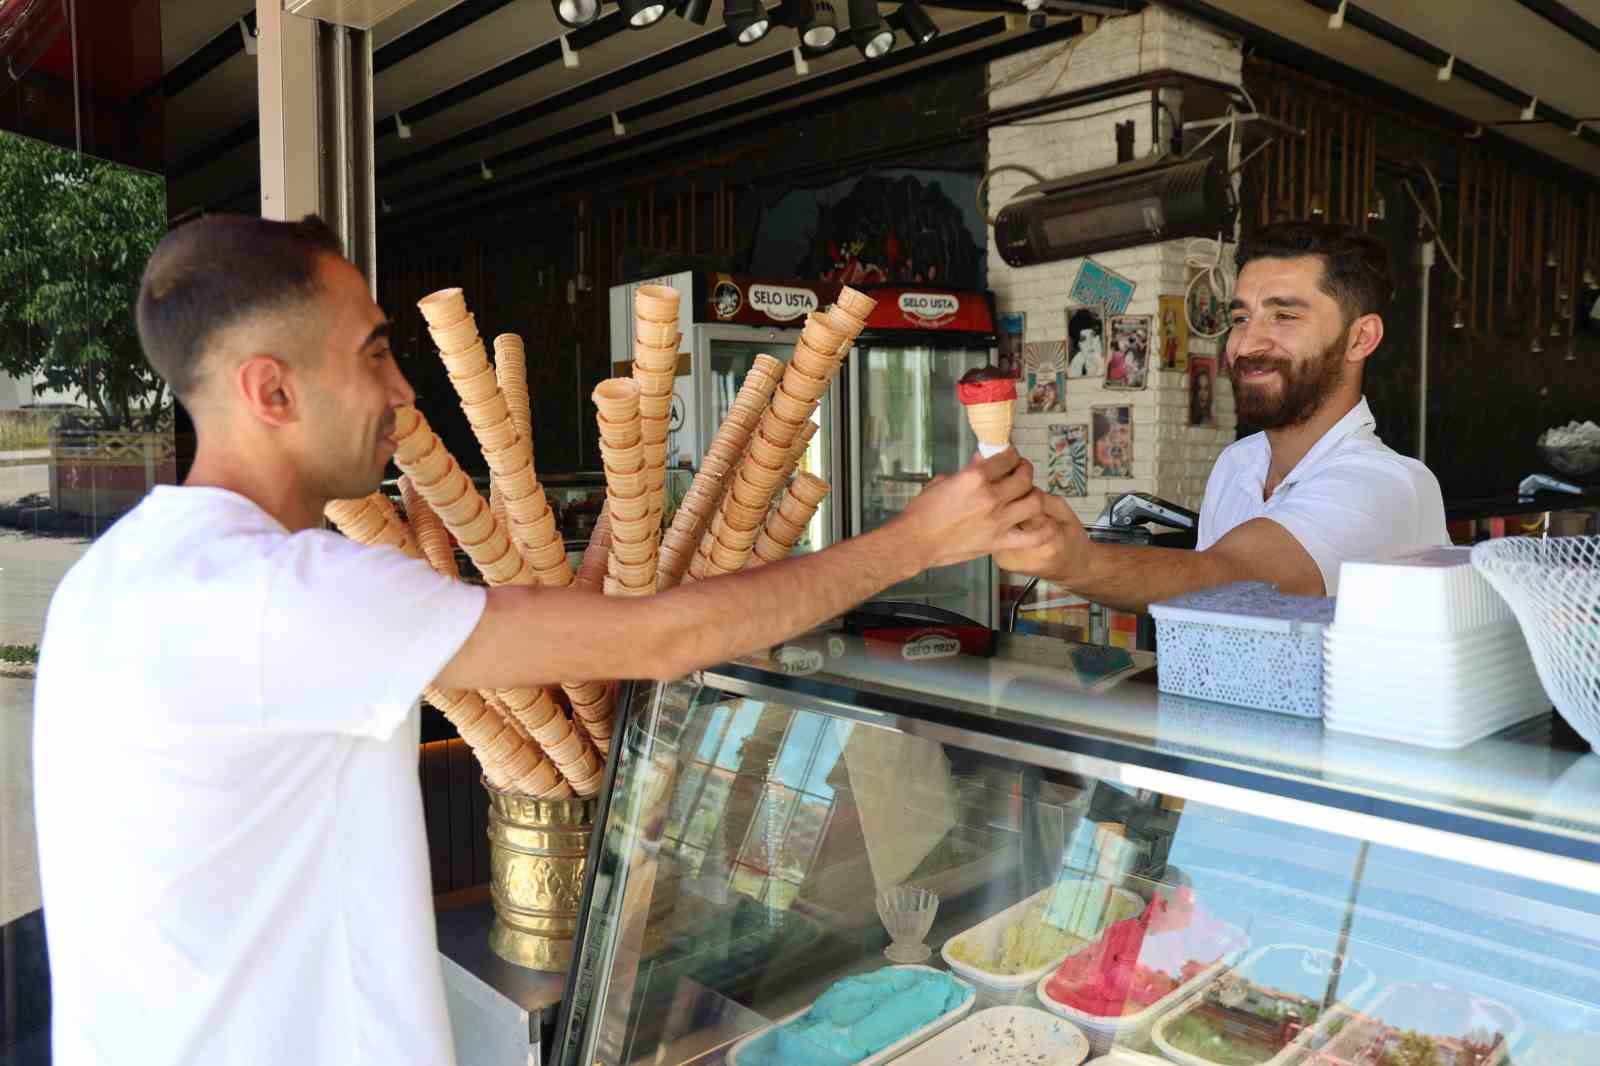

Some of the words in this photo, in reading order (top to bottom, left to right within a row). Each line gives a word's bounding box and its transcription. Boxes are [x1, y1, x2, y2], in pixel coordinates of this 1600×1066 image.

[753, 290, 783, 306] SELO
[784, 293, 814, 309] USTA
[903, 297, 929, 309] SELO
[930, 298, 955, 310] USTA
